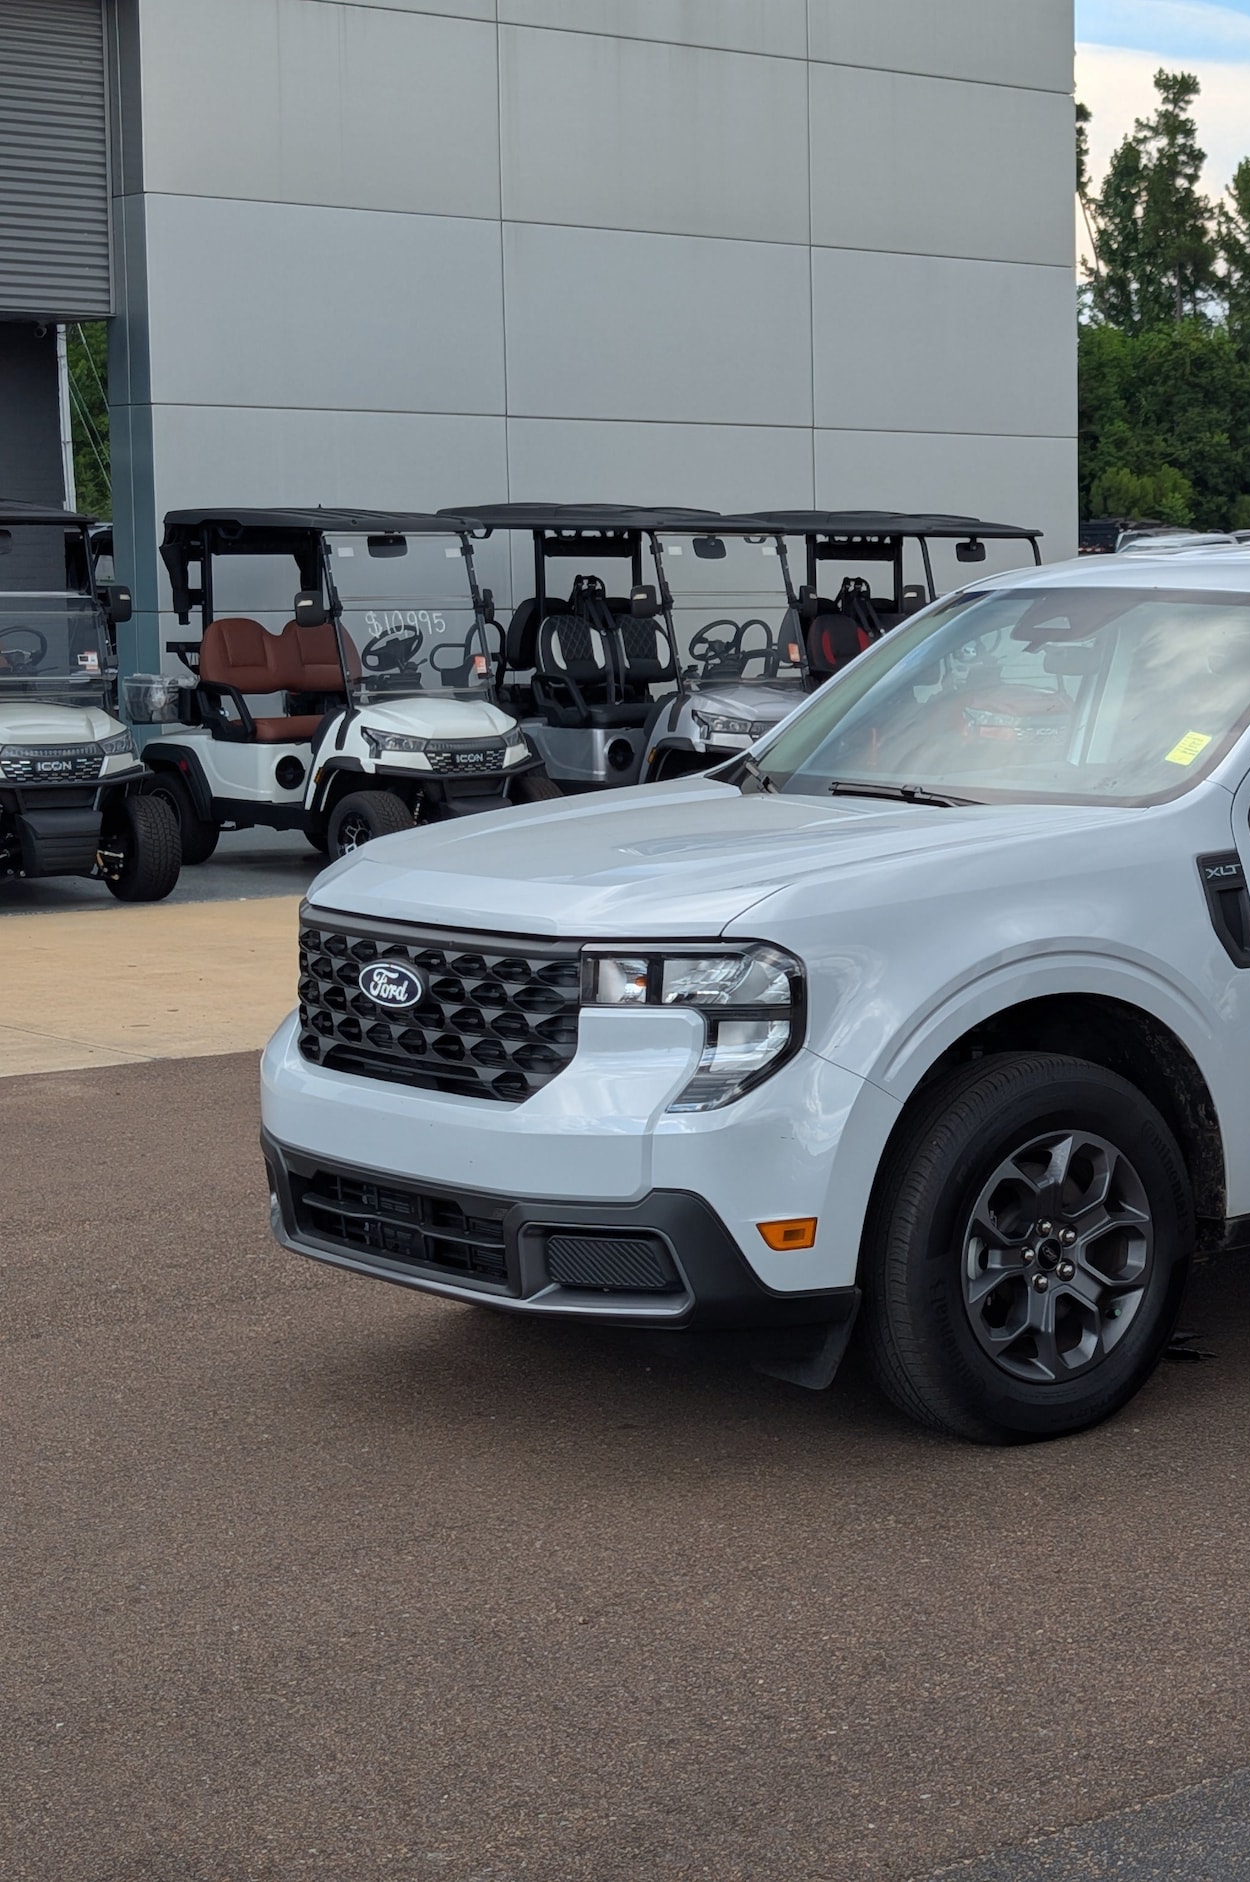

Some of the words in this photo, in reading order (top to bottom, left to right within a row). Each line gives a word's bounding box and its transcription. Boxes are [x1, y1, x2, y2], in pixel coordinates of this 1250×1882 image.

[365, 610, 446, 638] $10,995
[37, 761, 72, 771] ICON
[456, 755, 484, 765] ICON
[1206, 864, 1240, 878] XLT
[369, 969, 408, 1001] Ford
